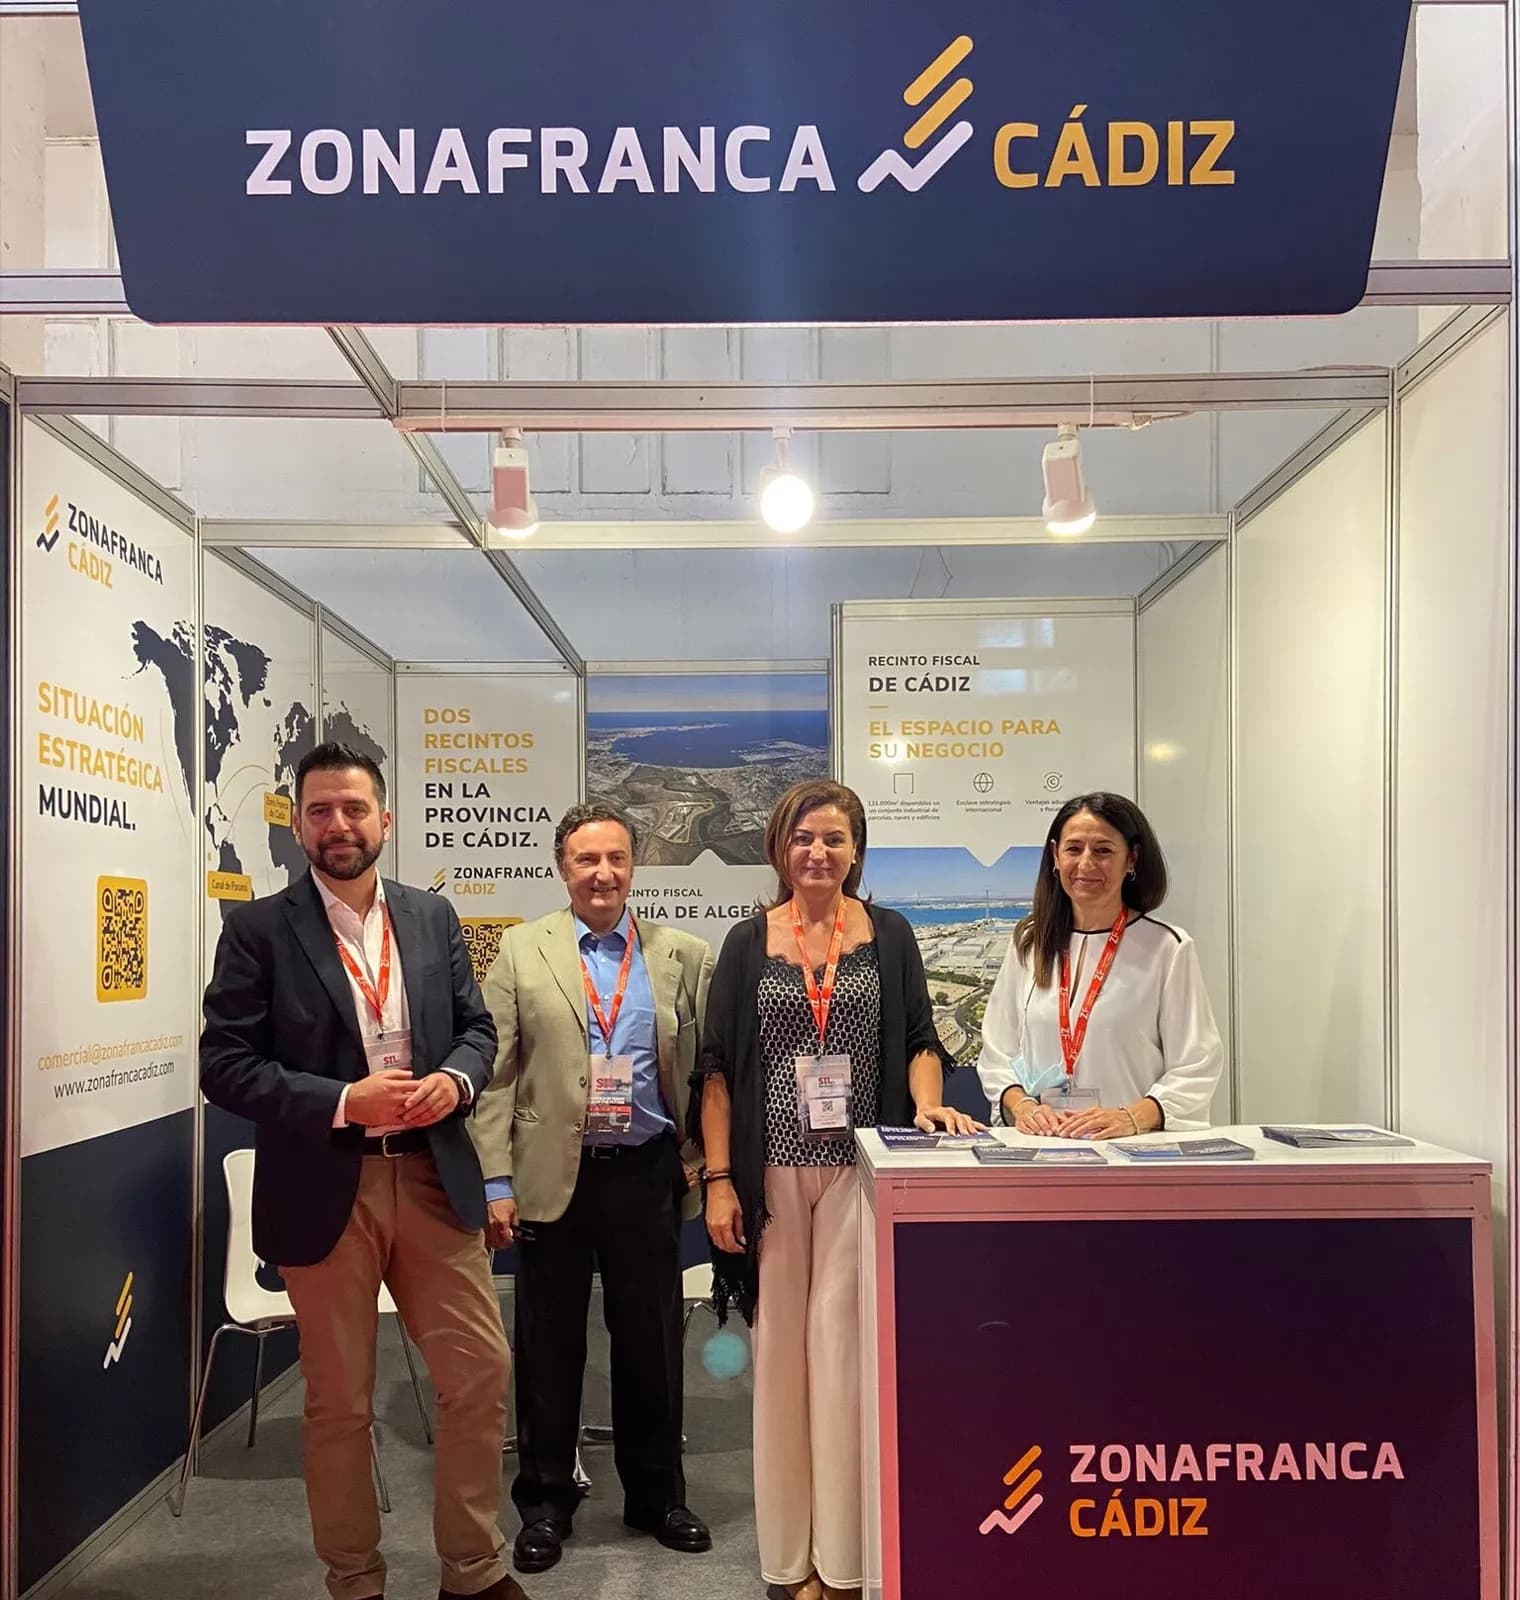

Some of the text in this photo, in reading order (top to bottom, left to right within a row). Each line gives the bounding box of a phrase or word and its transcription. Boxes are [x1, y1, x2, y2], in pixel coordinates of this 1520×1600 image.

[246, 104, 1236, 196] ZONAFRANCA CÁDIZ
[67, 502, 163, 585] ZONAFRANCA
[67, 541, 113, 590] CÁDIZ
[868, 655, 981, 667] RECINTO FISCAL
[869, 672, 970, 692] DE CÁDIZ
[38, 681, 144, 744] SITUACIÓN
[424, 708, 471, 725] DOS
[869, 719, 1061, 736] EL ESPACIO PARA
[424, 733, 534, 749] RECINTOS
[869, 742, 1004, 759] SU NEGOCIO
[38, 732, 163, 793] ESTRATÉGICA
[424, 758, 528, 775] FISCALES
[425, 783, 491, 799] EN LA
[38, 784, 137, 831] MUNDIAL.
[425, 807, 552, 824] PROVINCIA
[425, 827, 538, 848] DE CÁDIZ.
[454, 866, 554, 880] ZONAFRANCA
[453, 880, 496, 895] CÁDIZ
[664, 888, 703, 898] FISCAL
[675, 905, 699, 919] DE
[37, 1033, 184, 1072] comercial@zonafrancacadiz.com
[53, 1060, 175, 1099] www.zonafrancacadiz.com
[1069, 1442, 1405, 1483] ZONAFRANCA
[1069, 1488, 1209, 1537] CÁDIZ
